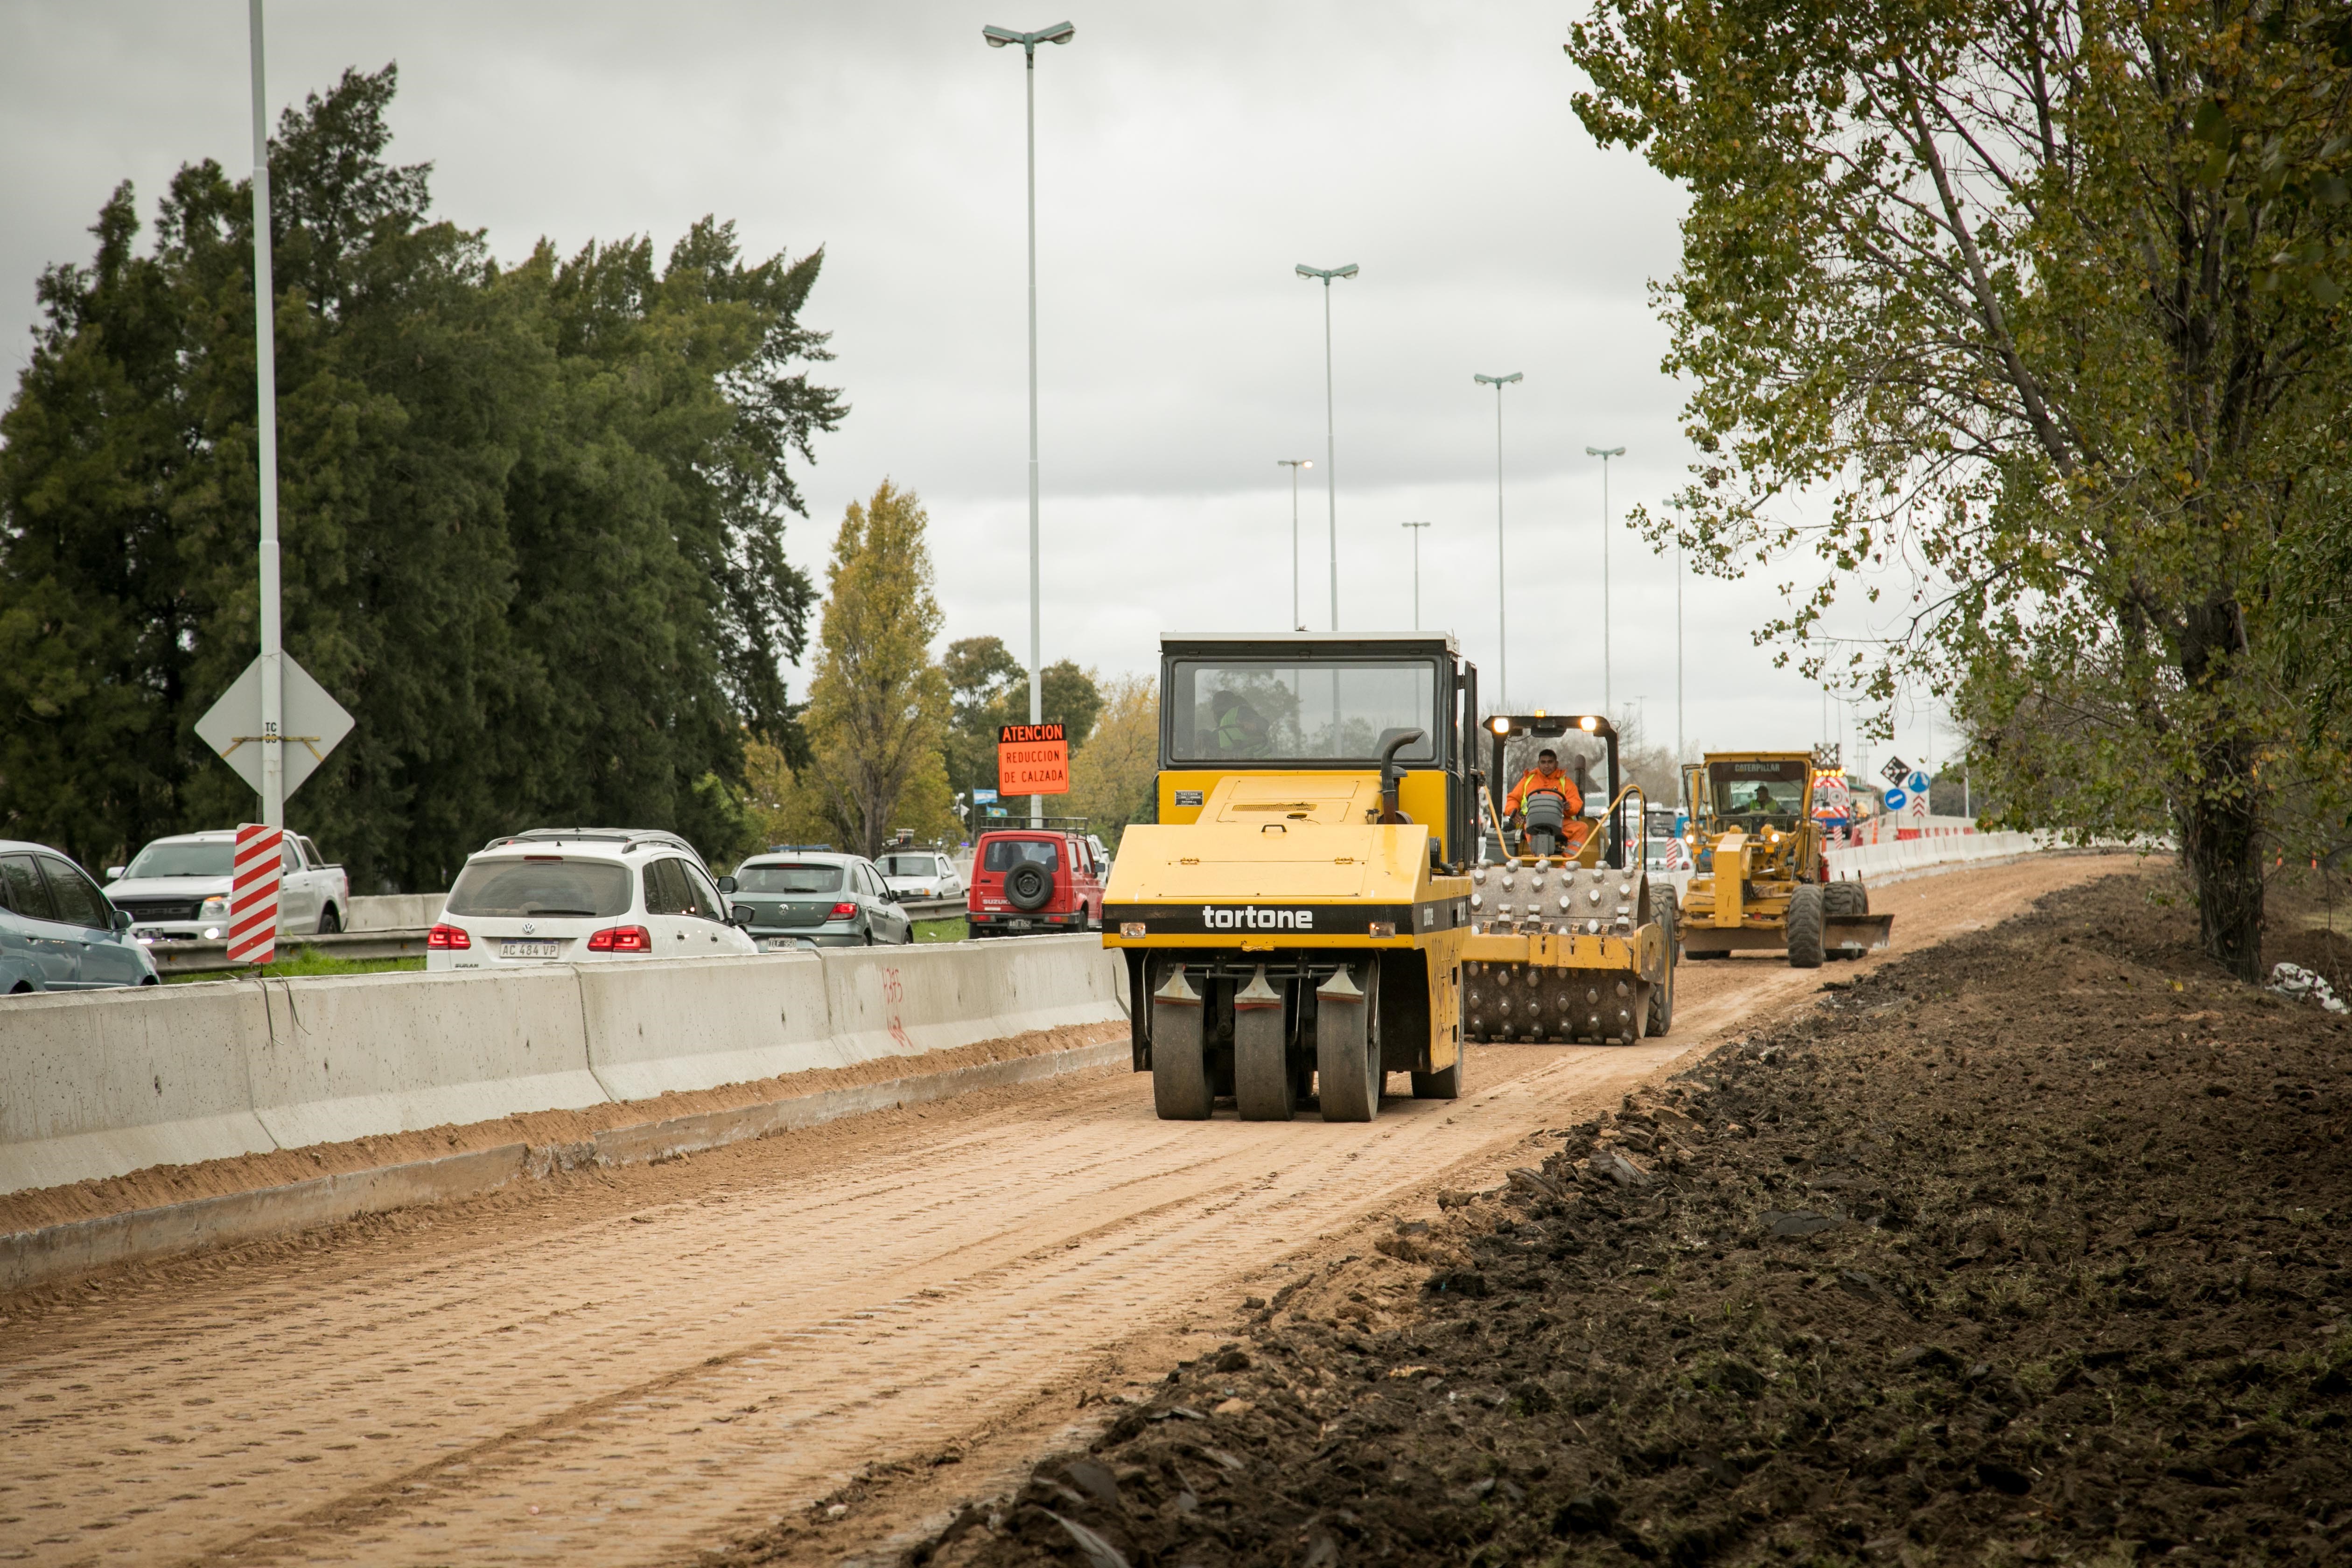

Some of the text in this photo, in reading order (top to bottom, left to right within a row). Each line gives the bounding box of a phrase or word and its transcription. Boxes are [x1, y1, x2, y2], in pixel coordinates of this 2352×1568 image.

[265, 722, 276, 732] TC
[1002, 724, 1063, 742] ATENCION
[1006, 750, 1059, 763] REDUCCION
[1735, 763, 1780, 772] CATERPILLAR
[1005, 770, 1064, 783] DE CALZADA
[1203, 905, 1313, 928] tortone
[503, 945, 556, 955] AC 484 VP
